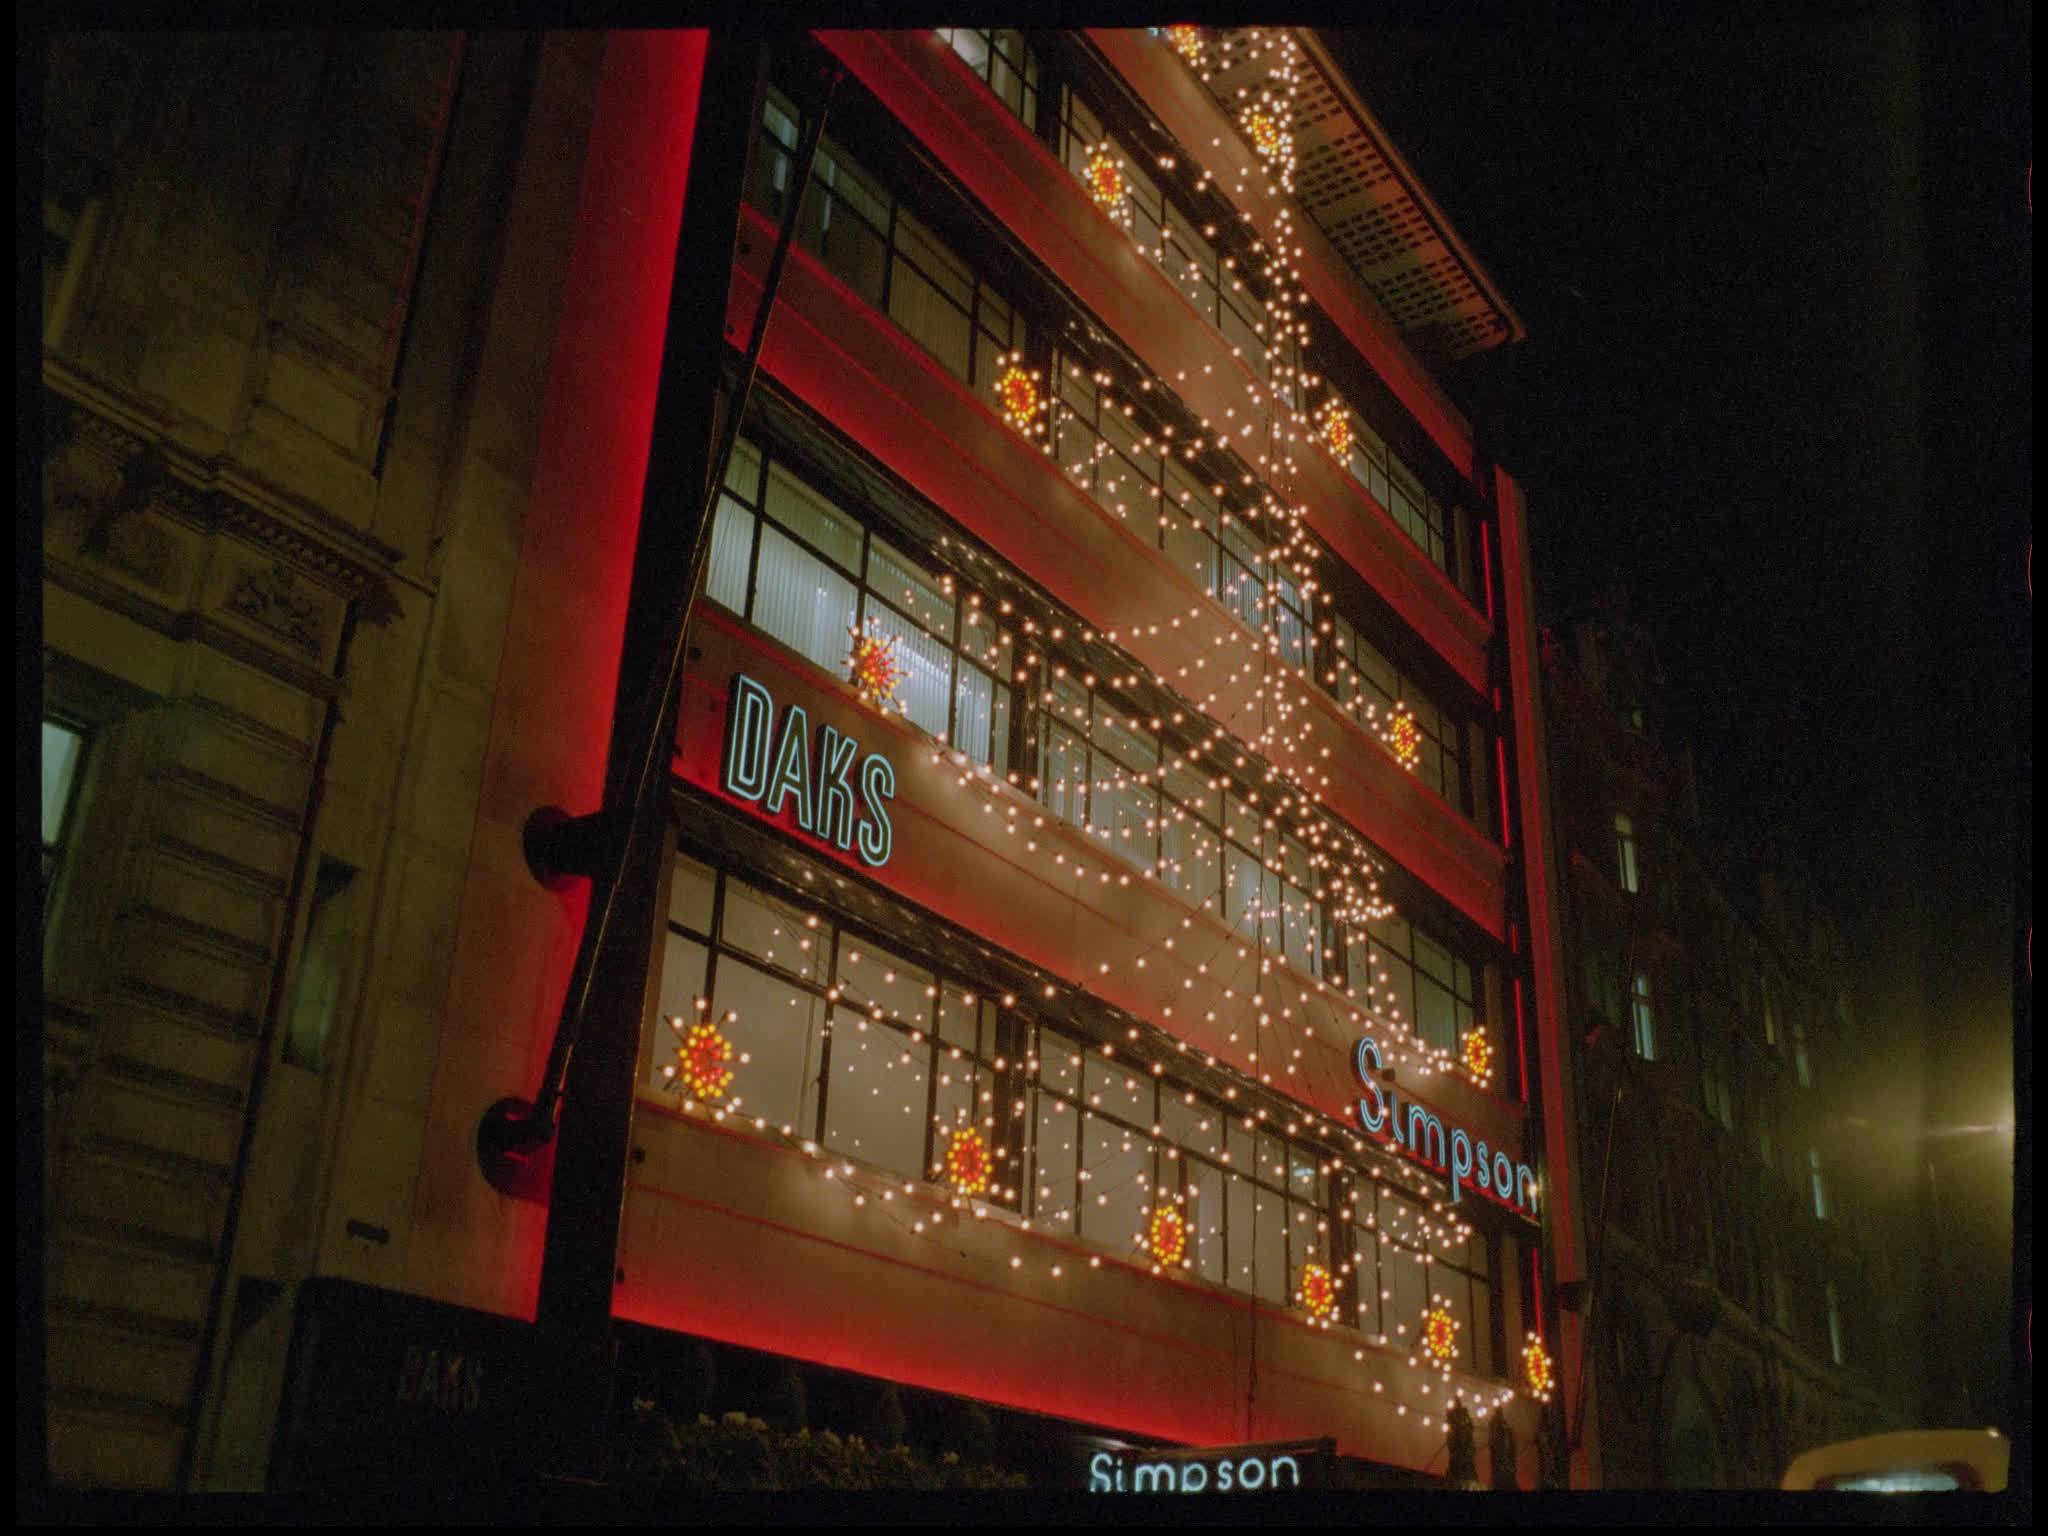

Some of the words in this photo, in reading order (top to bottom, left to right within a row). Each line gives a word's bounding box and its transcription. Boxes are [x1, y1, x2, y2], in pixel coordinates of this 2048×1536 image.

[727, 673, 895, 867] DAKS
[1358, 1037, 1538, 1214] Simpson
[1090, 1453, 1299, 1492] Simpson
